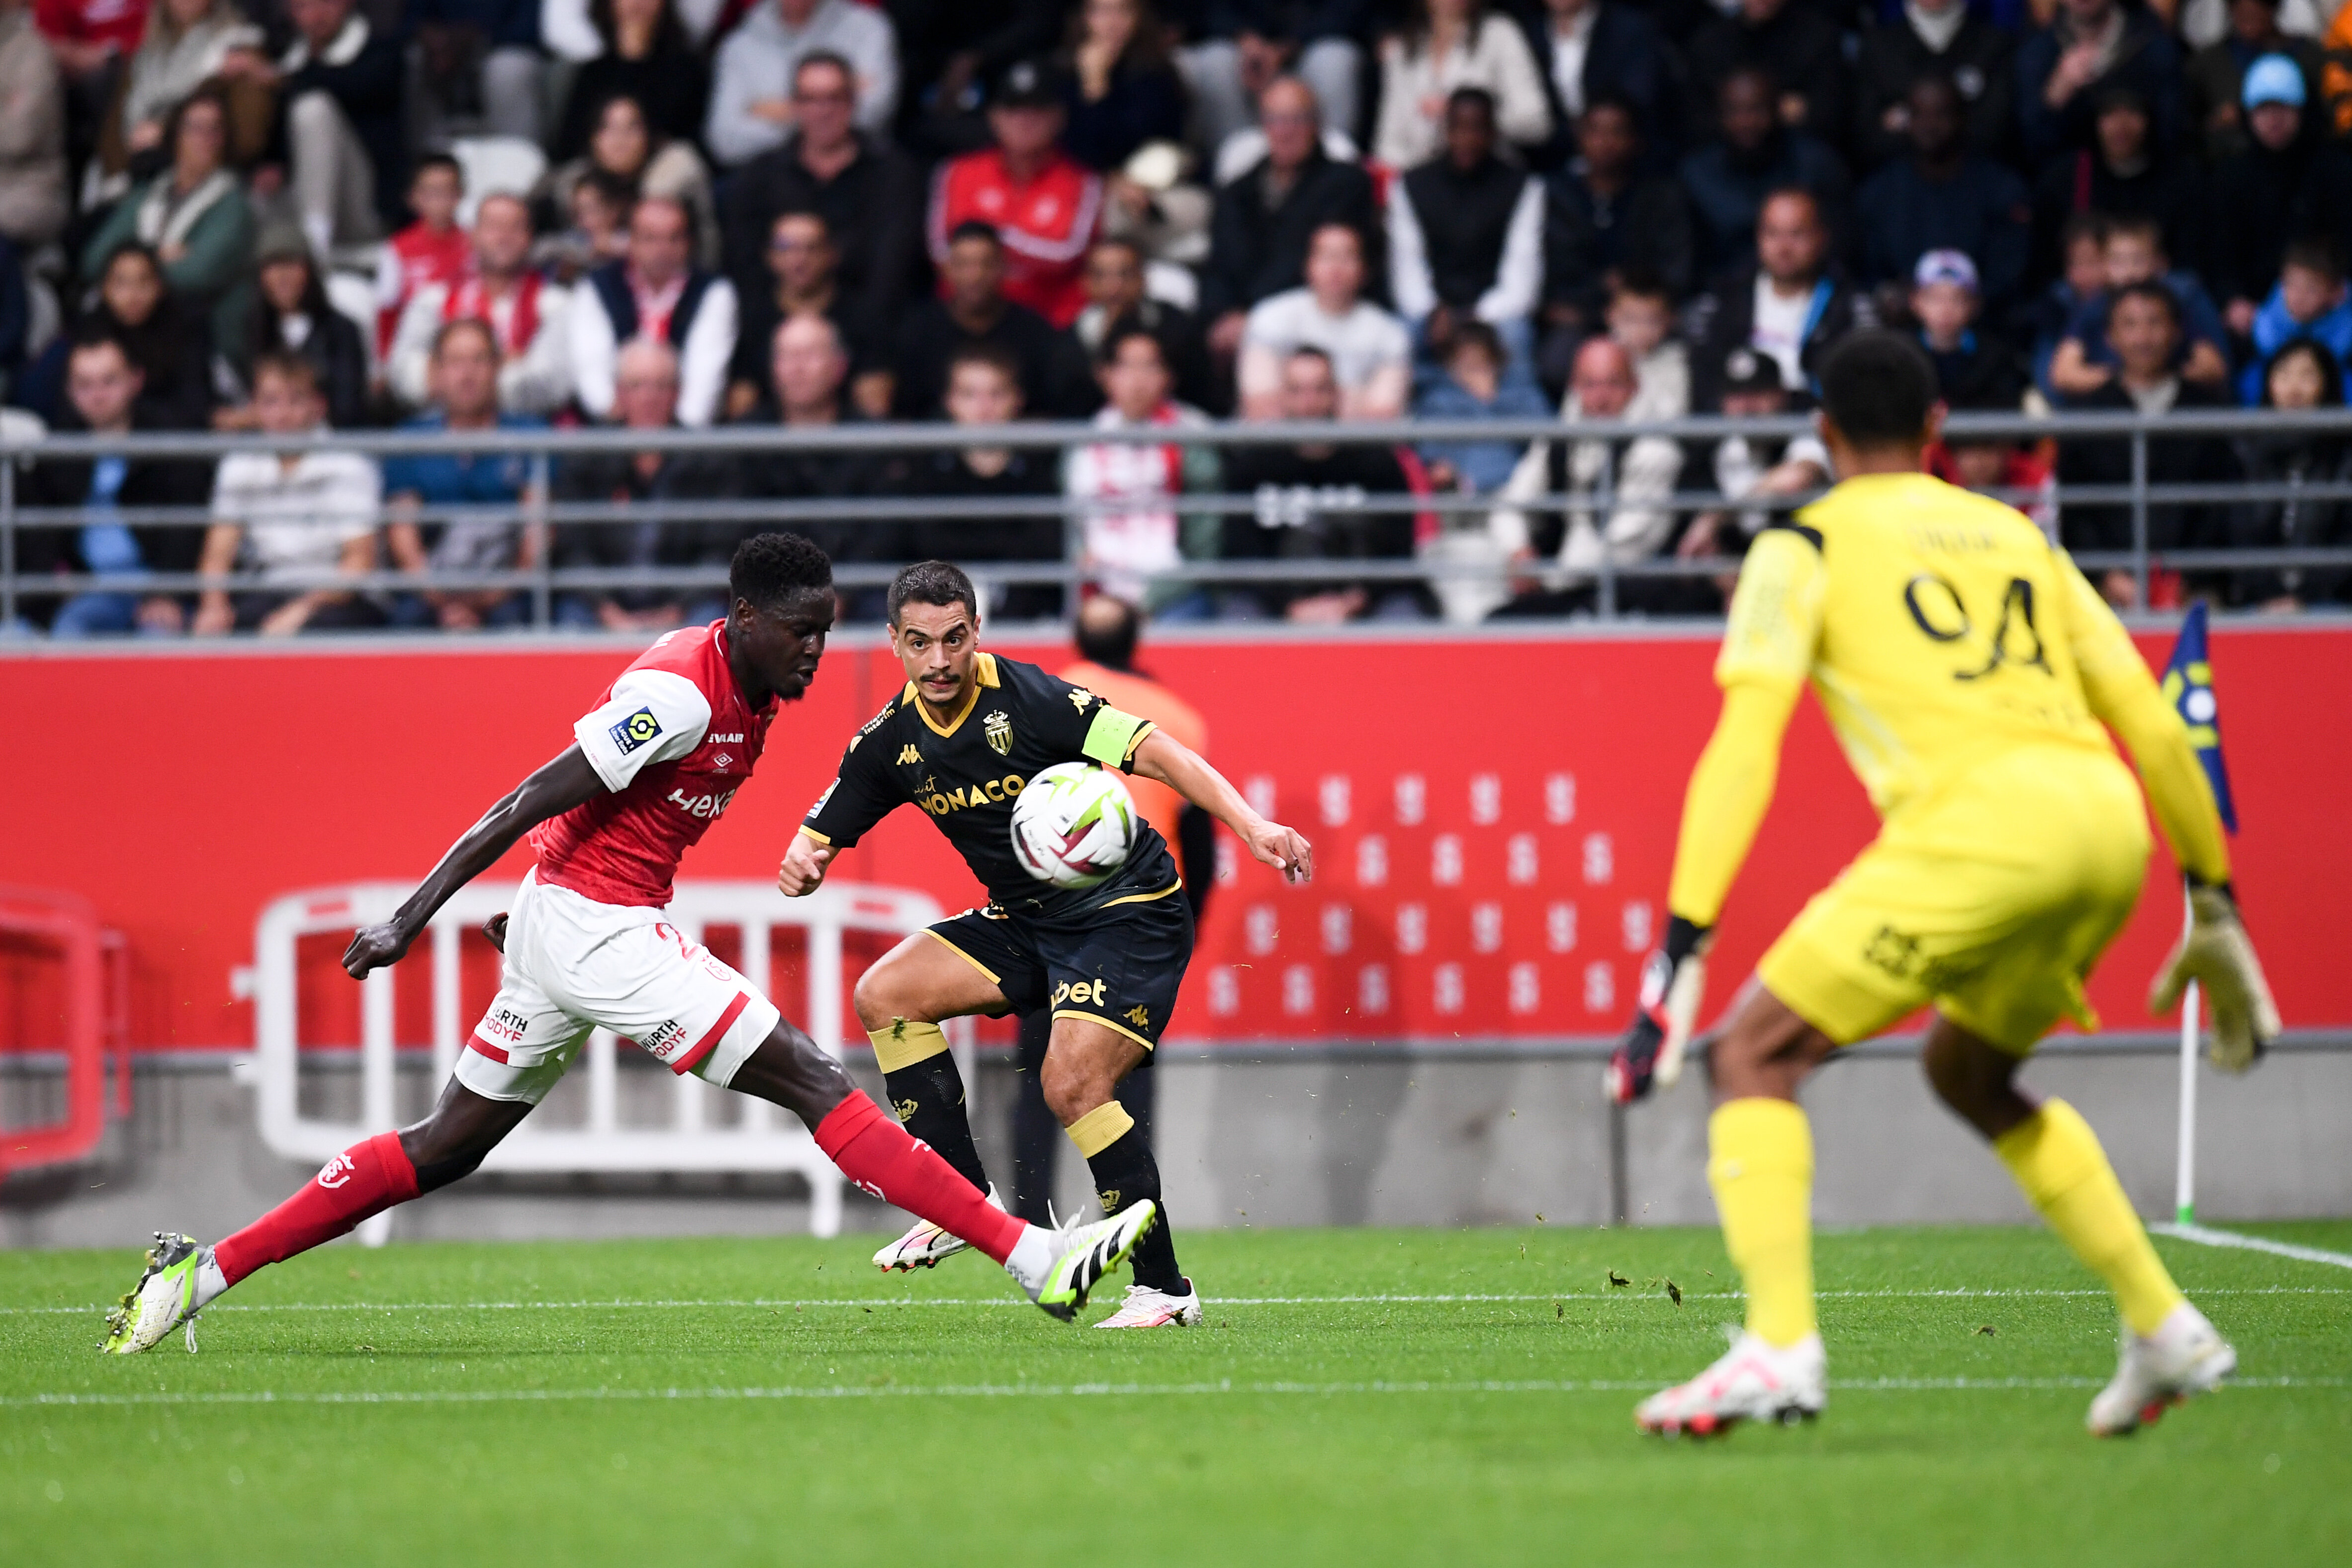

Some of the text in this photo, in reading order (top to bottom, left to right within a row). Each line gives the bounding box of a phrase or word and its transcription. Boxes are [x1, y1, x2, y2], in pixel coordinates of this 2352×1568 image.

[617, 725, 633, 745] LIGUE
[918, 774, 1025, 816] MONACO
[485, 1015, 523, 1042] ODYF
